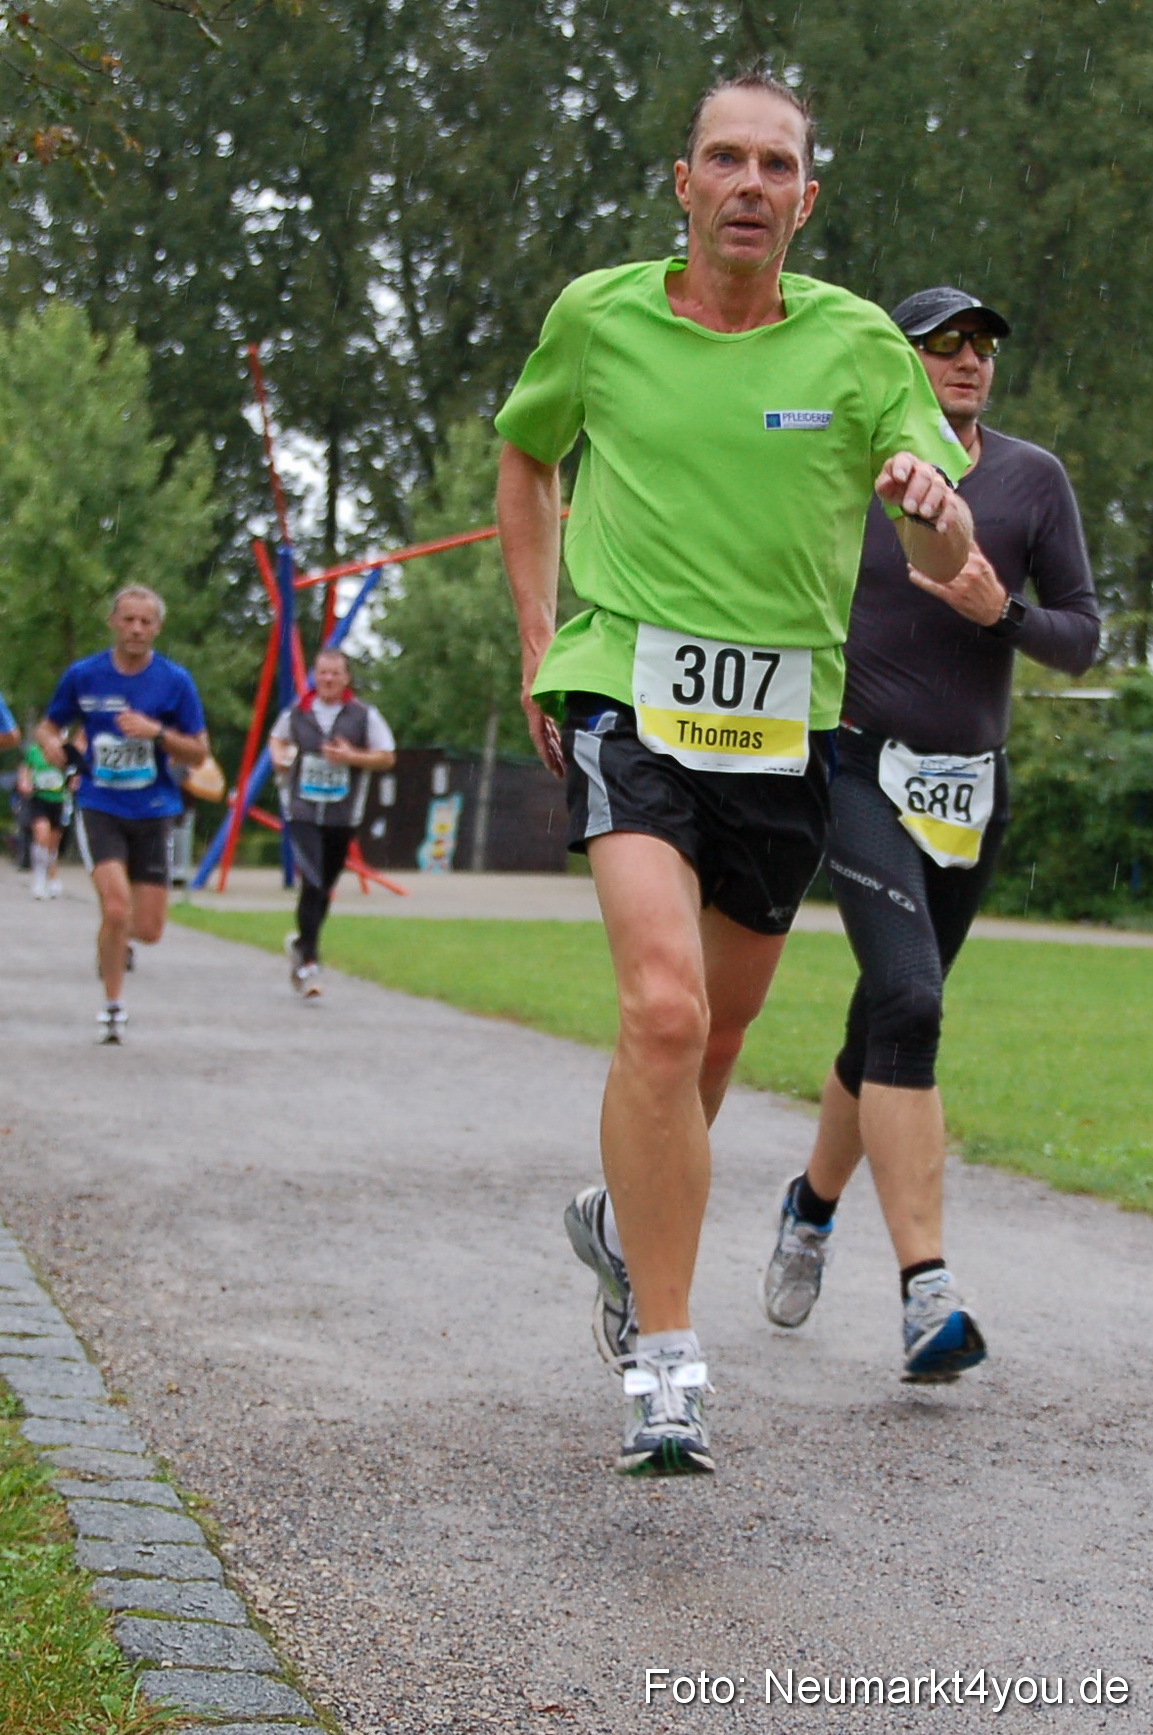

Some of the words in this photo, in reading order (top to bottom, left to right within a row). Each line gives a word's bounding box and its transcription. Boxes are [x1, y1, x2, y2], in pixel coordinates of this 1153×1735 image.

[672, 644, 781, 711] 307
[677, 720, 764, 750] Thomas
[904, 776, 974, 823] 689
